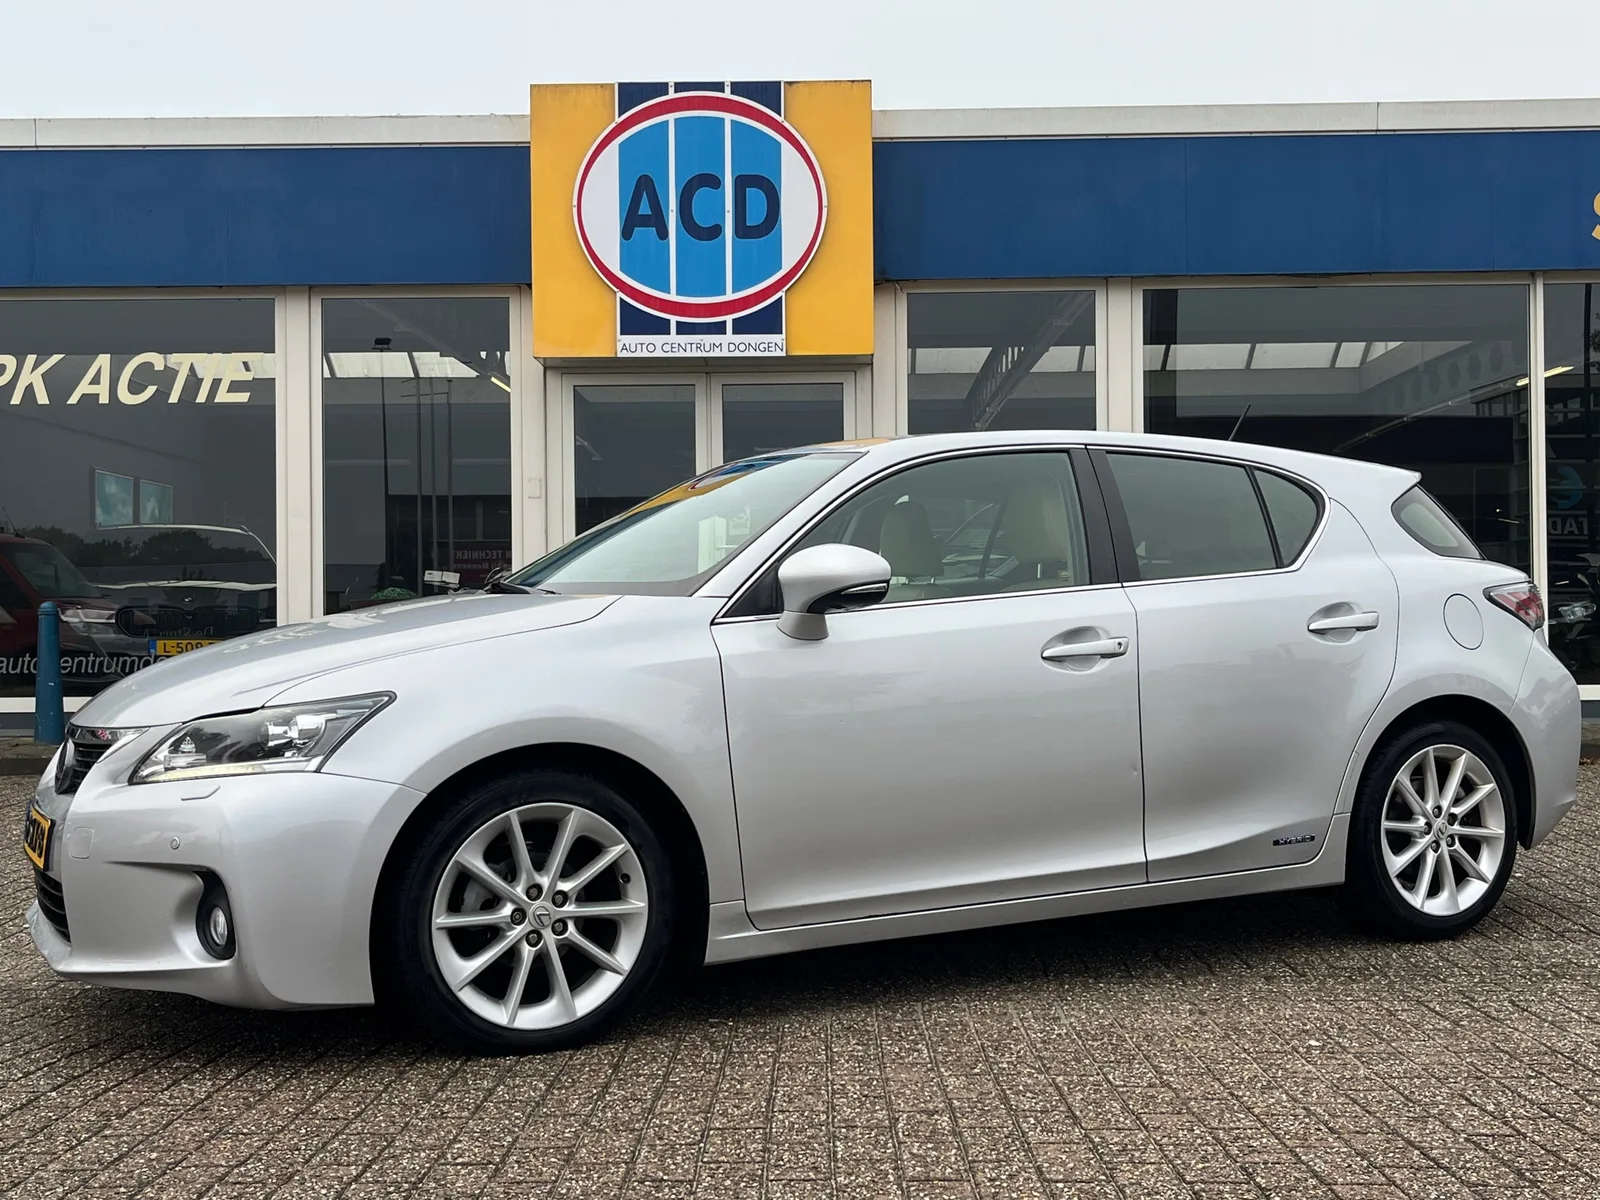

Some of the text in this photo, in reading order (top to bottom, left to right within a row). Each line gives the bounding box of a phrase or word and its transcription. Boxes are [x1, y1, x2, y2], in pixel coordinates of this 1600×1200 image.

[621, 172, 781, 242] ACD
[620, 341, 784, 353] AUTO CENTRUM DONGEN
[66, 352, 264, 405] ACTIE
